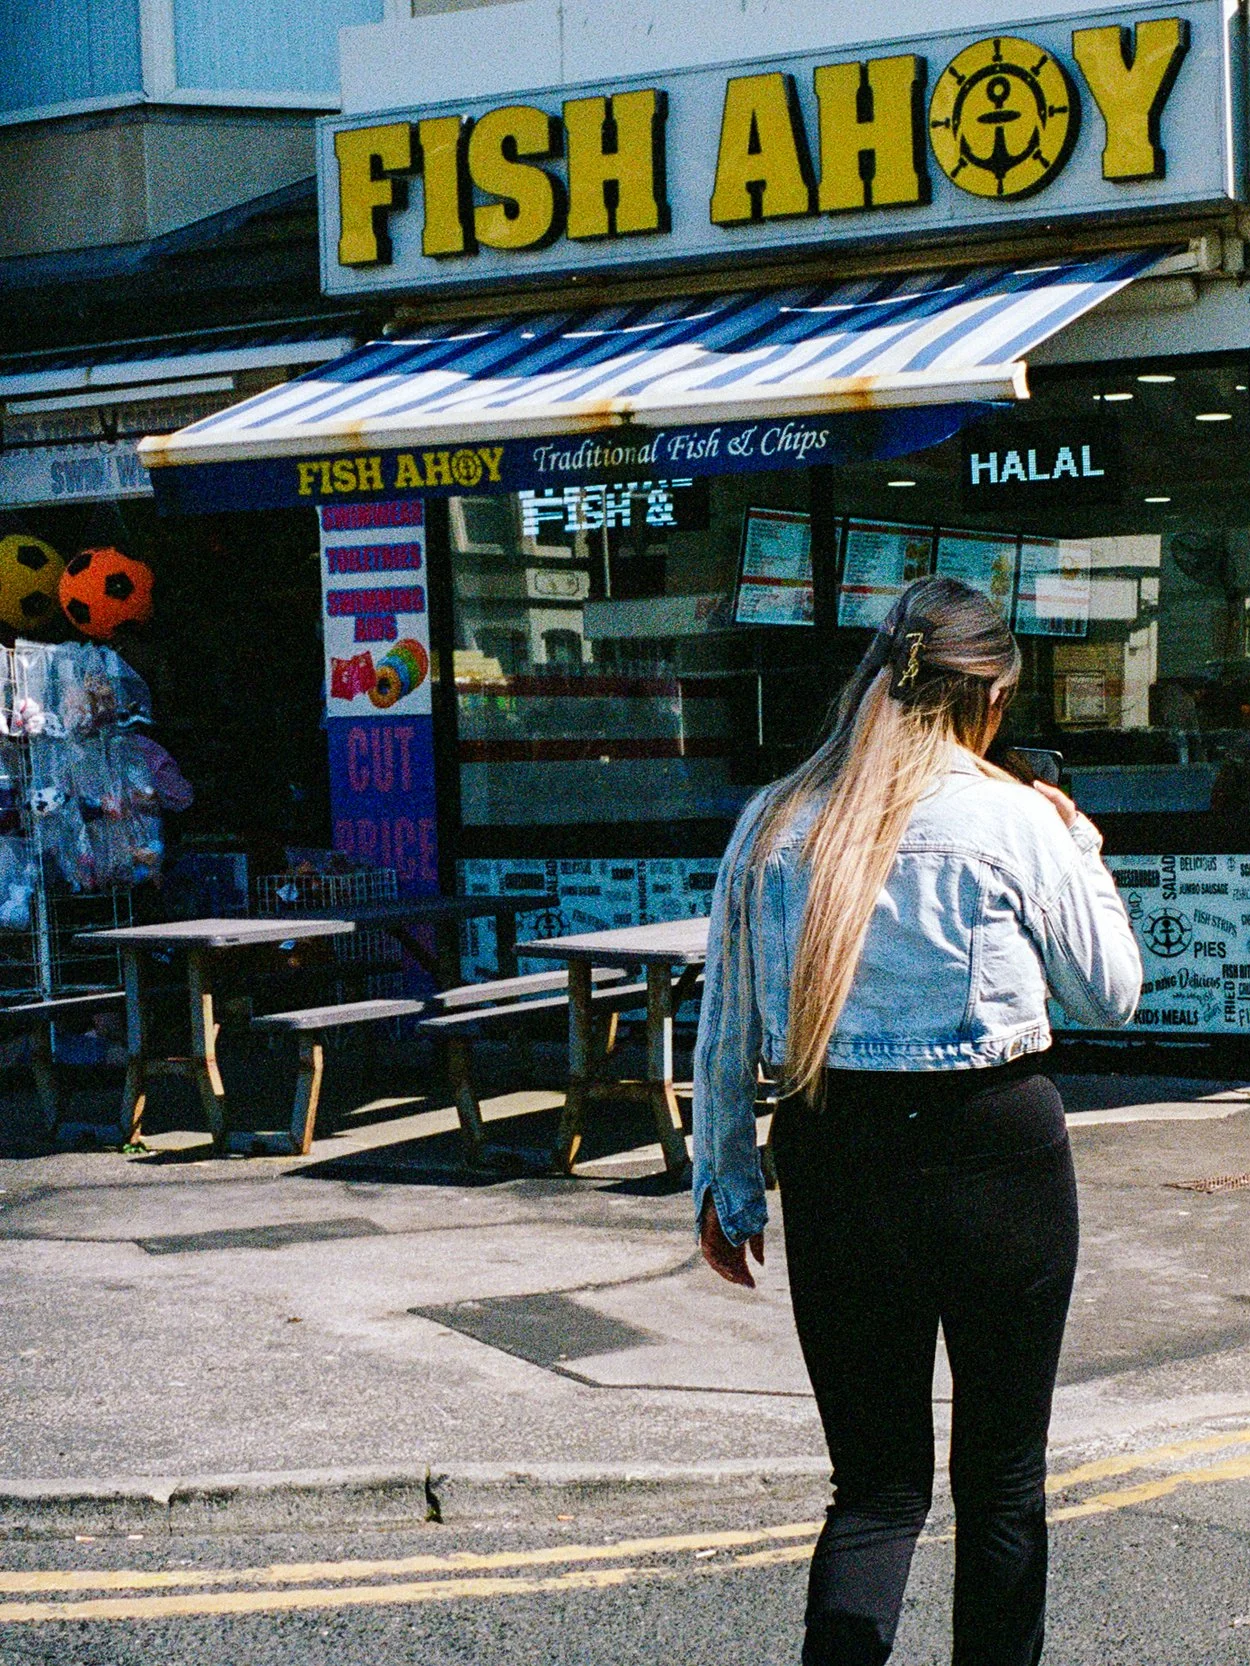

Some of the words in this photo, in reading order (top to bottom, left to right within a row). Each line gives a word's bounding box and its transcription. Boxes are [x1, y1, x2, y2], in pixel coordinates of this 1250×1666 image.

[333, 89, 670, 268] FISH
[710, 17, 1190, 229] AHOY
[533, 432, 666, 473] Traditional
[667, 428, 721, 461] Fish
[727, 425, 757, 457] &
[760, 421, 830, 460] Chips
[970, 445, 1105, 485] HALAL
[296, 456, 385, 497] FISH
[394, 447, 505, 489] AHOY
[327, 585, 425, 617] SWIMMING
[347, 725, 415, 793] CUT
[1161, 855, 1177, 900] SALAD
[1193, 941, 1227, 959] PIES
[1134, 1009, 1160, 1025] KIDS
[1161, 1009, 1199, 1025] MEALS
[1224, 981, 1236, 1023] FRIED
